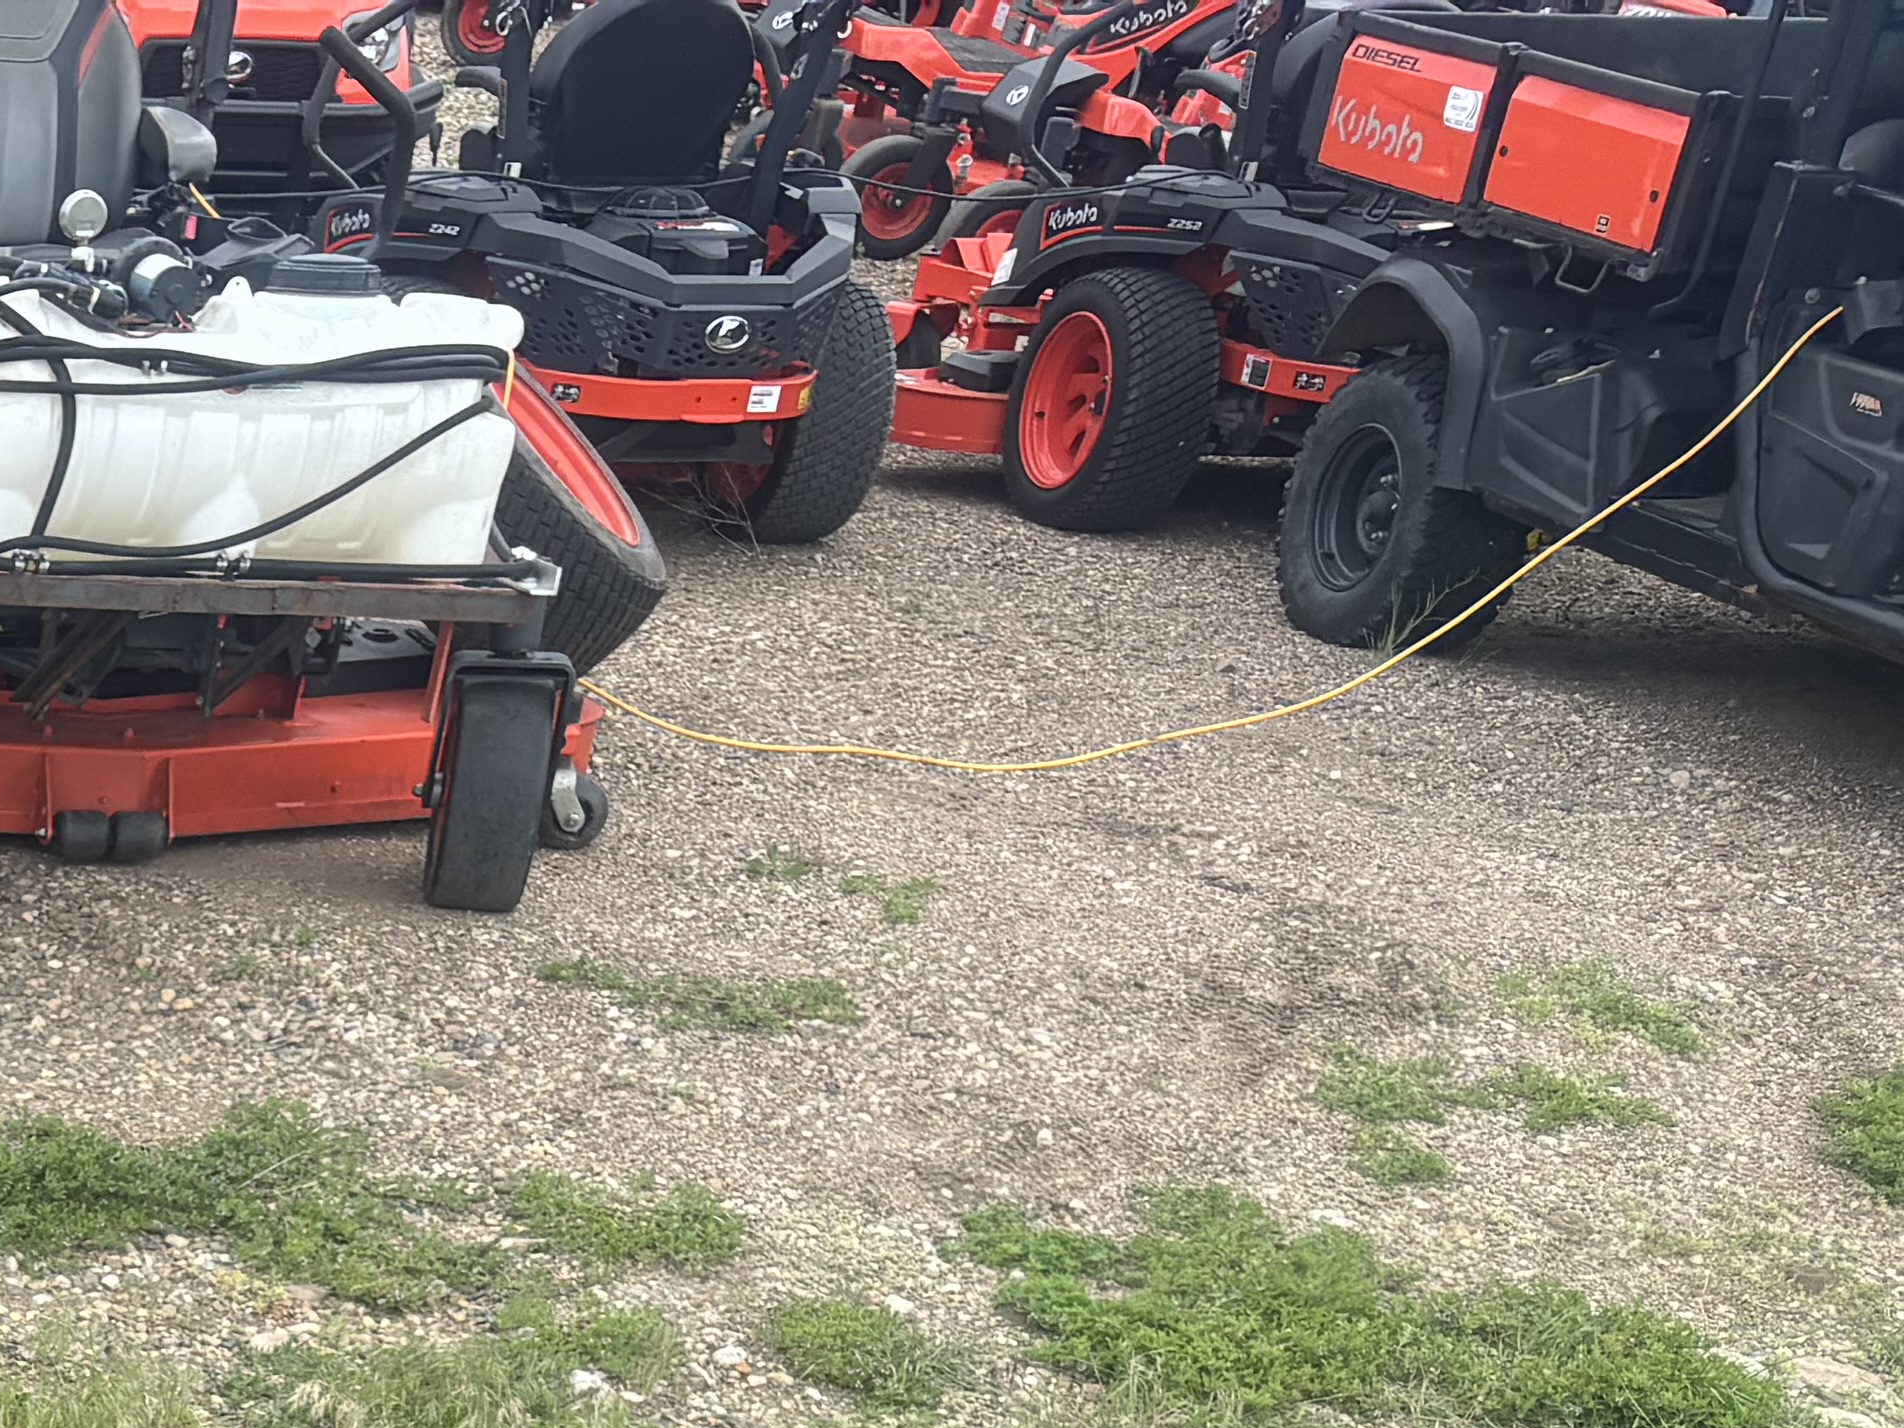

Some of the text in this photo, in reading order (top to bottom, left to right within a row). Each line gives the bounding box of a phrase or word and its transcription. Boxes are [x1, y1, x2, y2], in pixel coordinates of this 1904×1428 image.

[1110, 0, 1187, 34] Kubota
[1352, 44, 1421, 72] DIESEL
[1332, 96, 1423, 164] Kubota
[1048, 202, 1098, 230] Kubota
